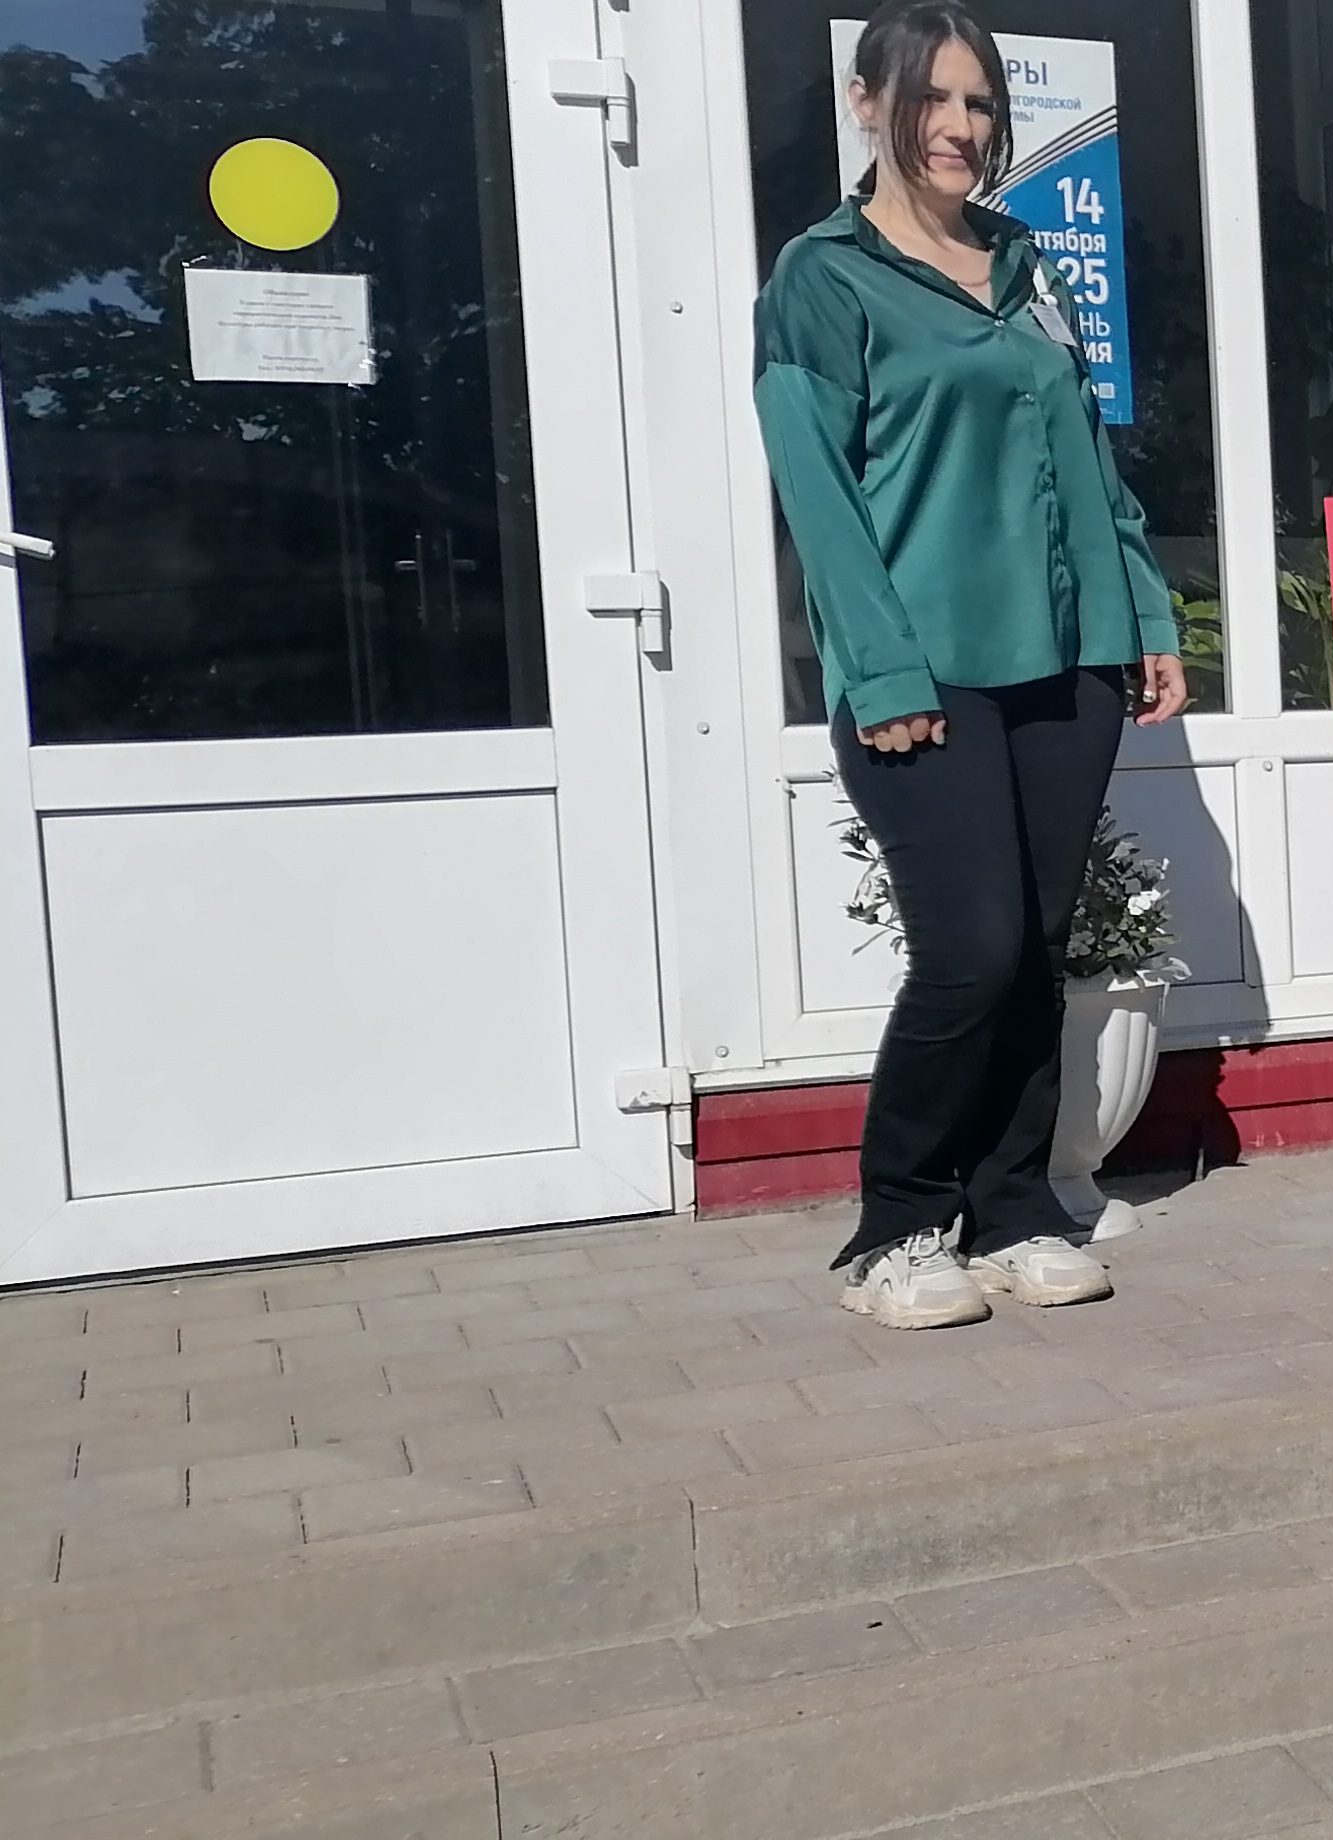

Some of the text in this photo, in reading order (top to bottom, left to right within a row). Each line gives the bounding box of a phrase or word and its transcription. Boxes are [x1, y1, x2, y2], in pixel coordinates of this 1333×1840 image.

[1005, 58, 1048, 86] РЫ
[1010, 111, 1035, 123] МЫ
[1057, 176, 1105, 225] 14
[1029, 226, 1107, 257] нтября
[1057, 257, 1109, 305] 25
[1079, 310, 1112, 337] НЬ
[1083, 341, 1113, 363] ИЯ
